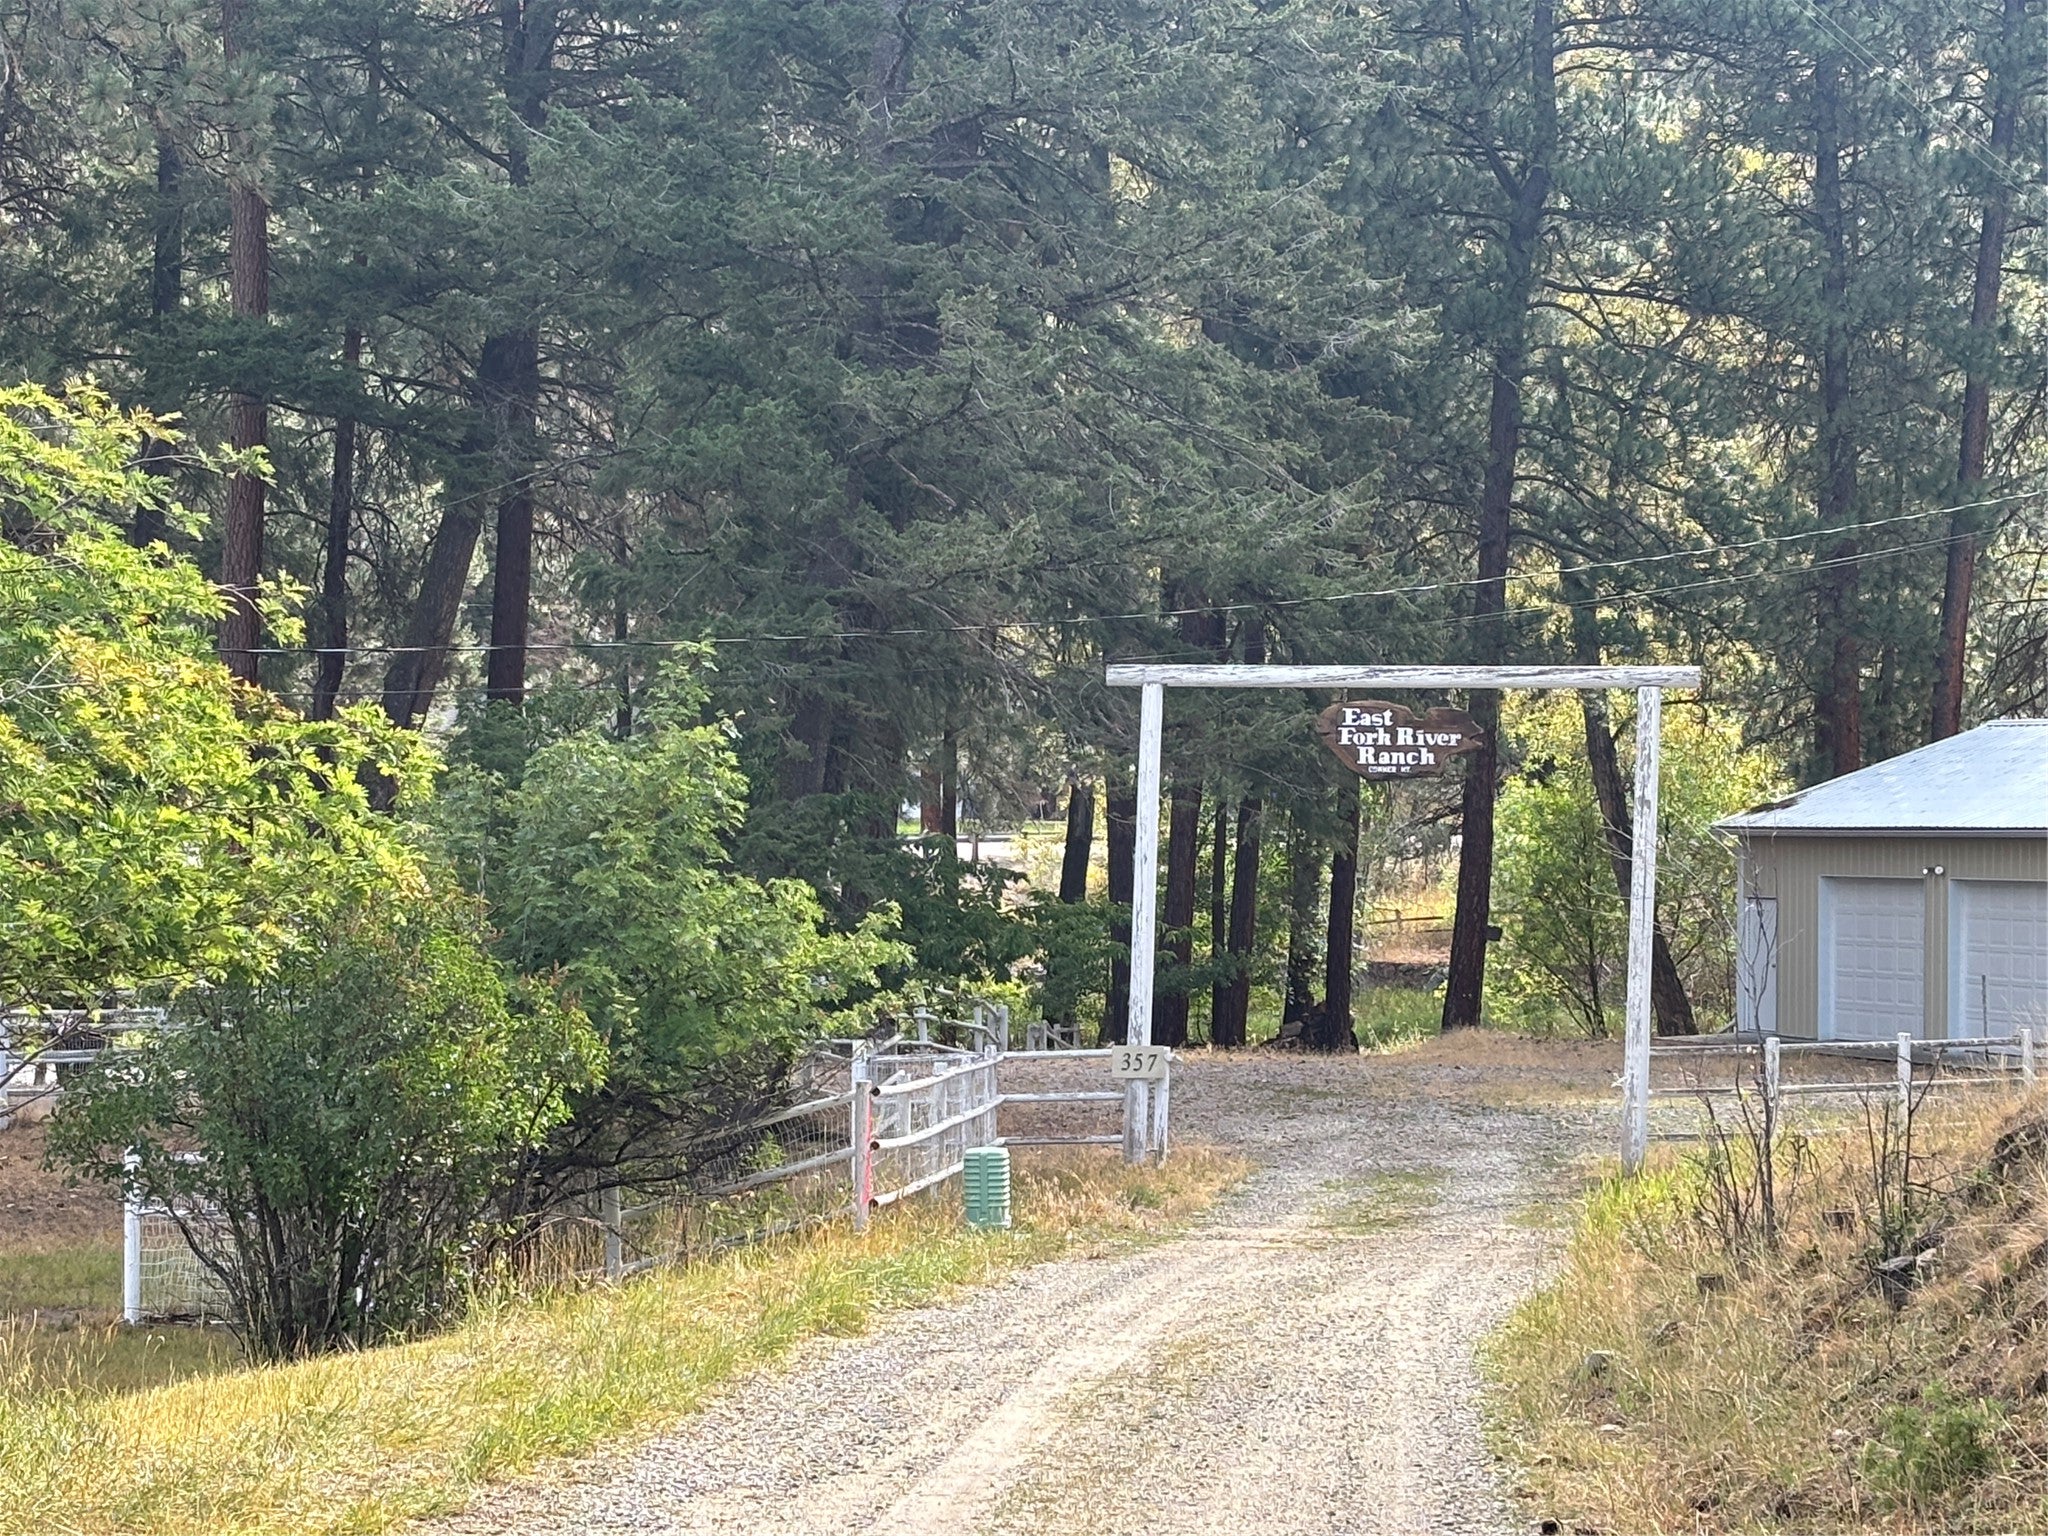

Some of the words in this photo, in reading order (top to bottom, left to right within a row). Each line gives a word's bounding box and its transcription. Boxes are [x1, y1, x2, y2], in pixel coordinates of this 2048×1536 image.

[1342, 707, 1393, 726] East
[1338, 727, 1392, 745] Fork
[1396, 727, 1462, 746] River
[1357, 746, 1436, 765] Ranch
[1121, 1052, 1158, 1072] 357
